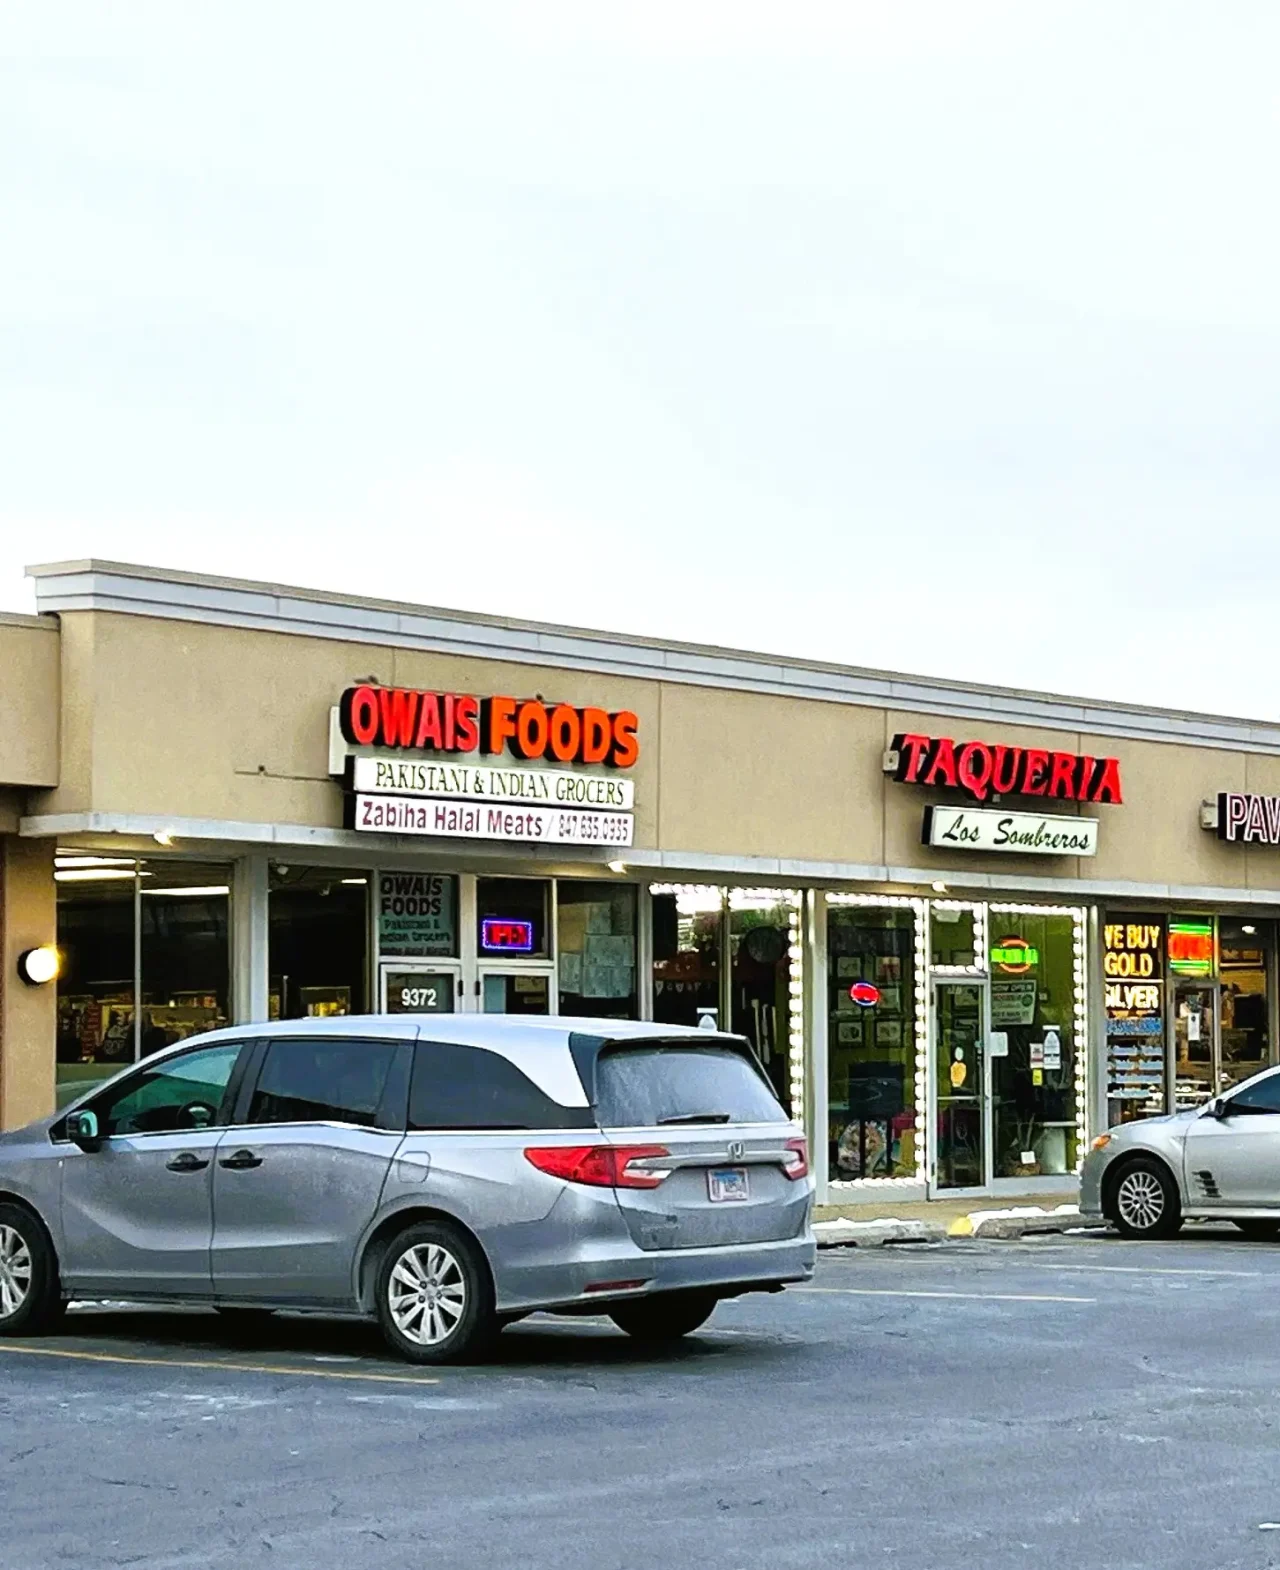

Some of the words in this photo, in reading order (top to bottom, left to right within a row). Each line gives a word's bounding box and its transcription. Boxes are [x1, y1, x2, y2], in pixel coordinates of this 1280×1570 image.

[350, 684, 479, 753] OWAIS
[489, 695, 640, 768] FOODS
[375, 761, 467, 793] PAKISTANI
[474, 774, 484, 794] &
[489, 771, 549, 799] INDIAN
[555, 777, 625, 806] GROCERS
[901, 733, 1123, 804] TAQUERIA
[362, 800, 427, 829] Zabiha
[434, 806, 480, 833] Halal
[487, 810, 543, 837] Meats
[941, 814, 980, 842] Los
[993, 818, 1090, 850] Sombreros
[381, 876, 443, 896] OWAIS
[381, 897, 442, 917] FOODS
[1126, 924, 1161, 950] BUY
[1104, 952, 1153, 977] GOLD
[401, 988, 437, 1007] 9372
